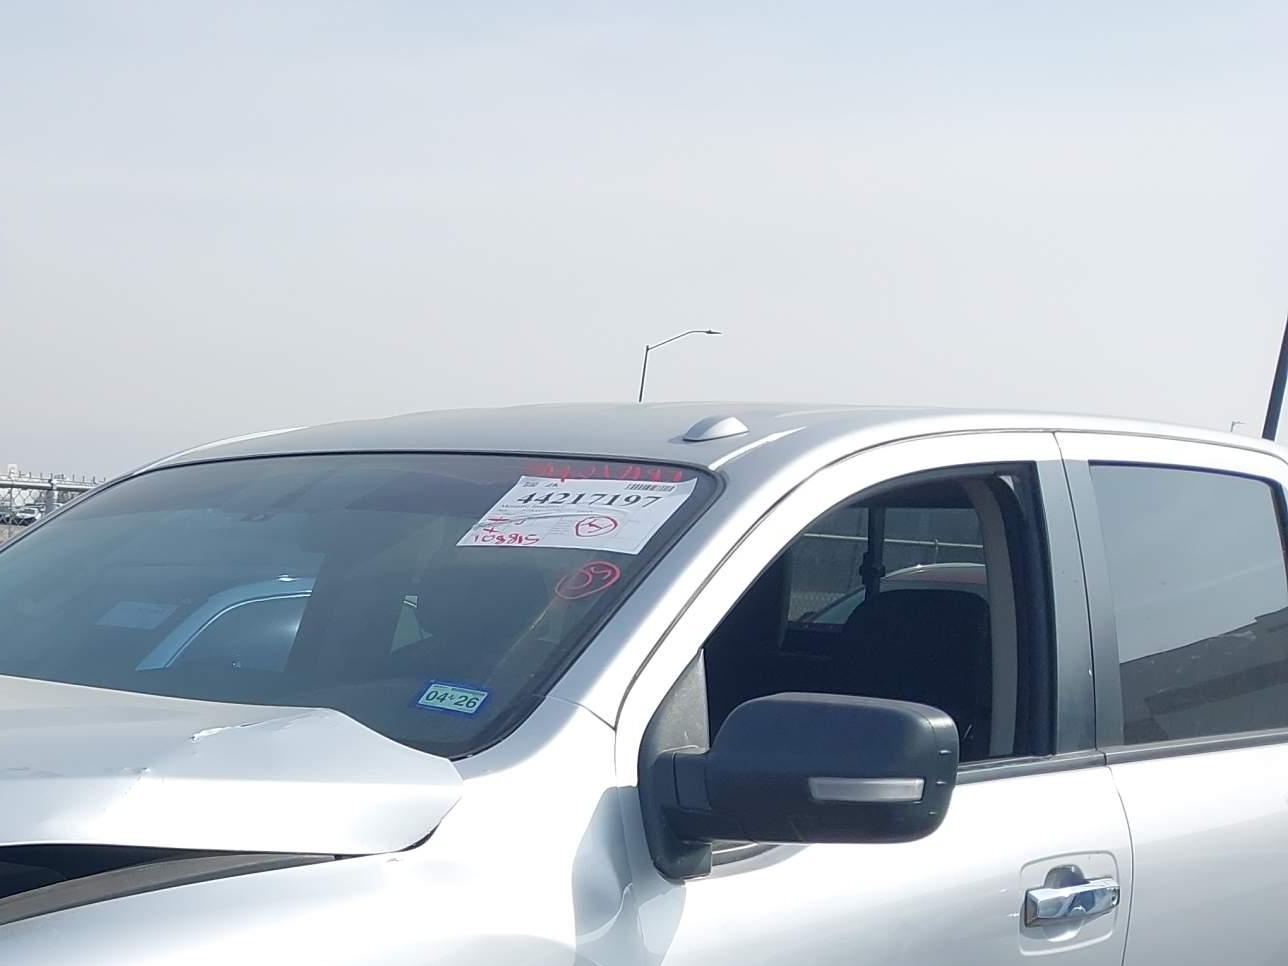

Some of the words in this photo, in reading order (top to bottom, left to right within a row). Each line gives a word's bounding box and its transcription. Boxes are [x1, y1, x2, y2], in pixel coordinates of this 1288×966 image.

[516, 491, 664, 508] 44217197
[425, 690, 449, 703] 04
[454, 695, 480, 708] 26
